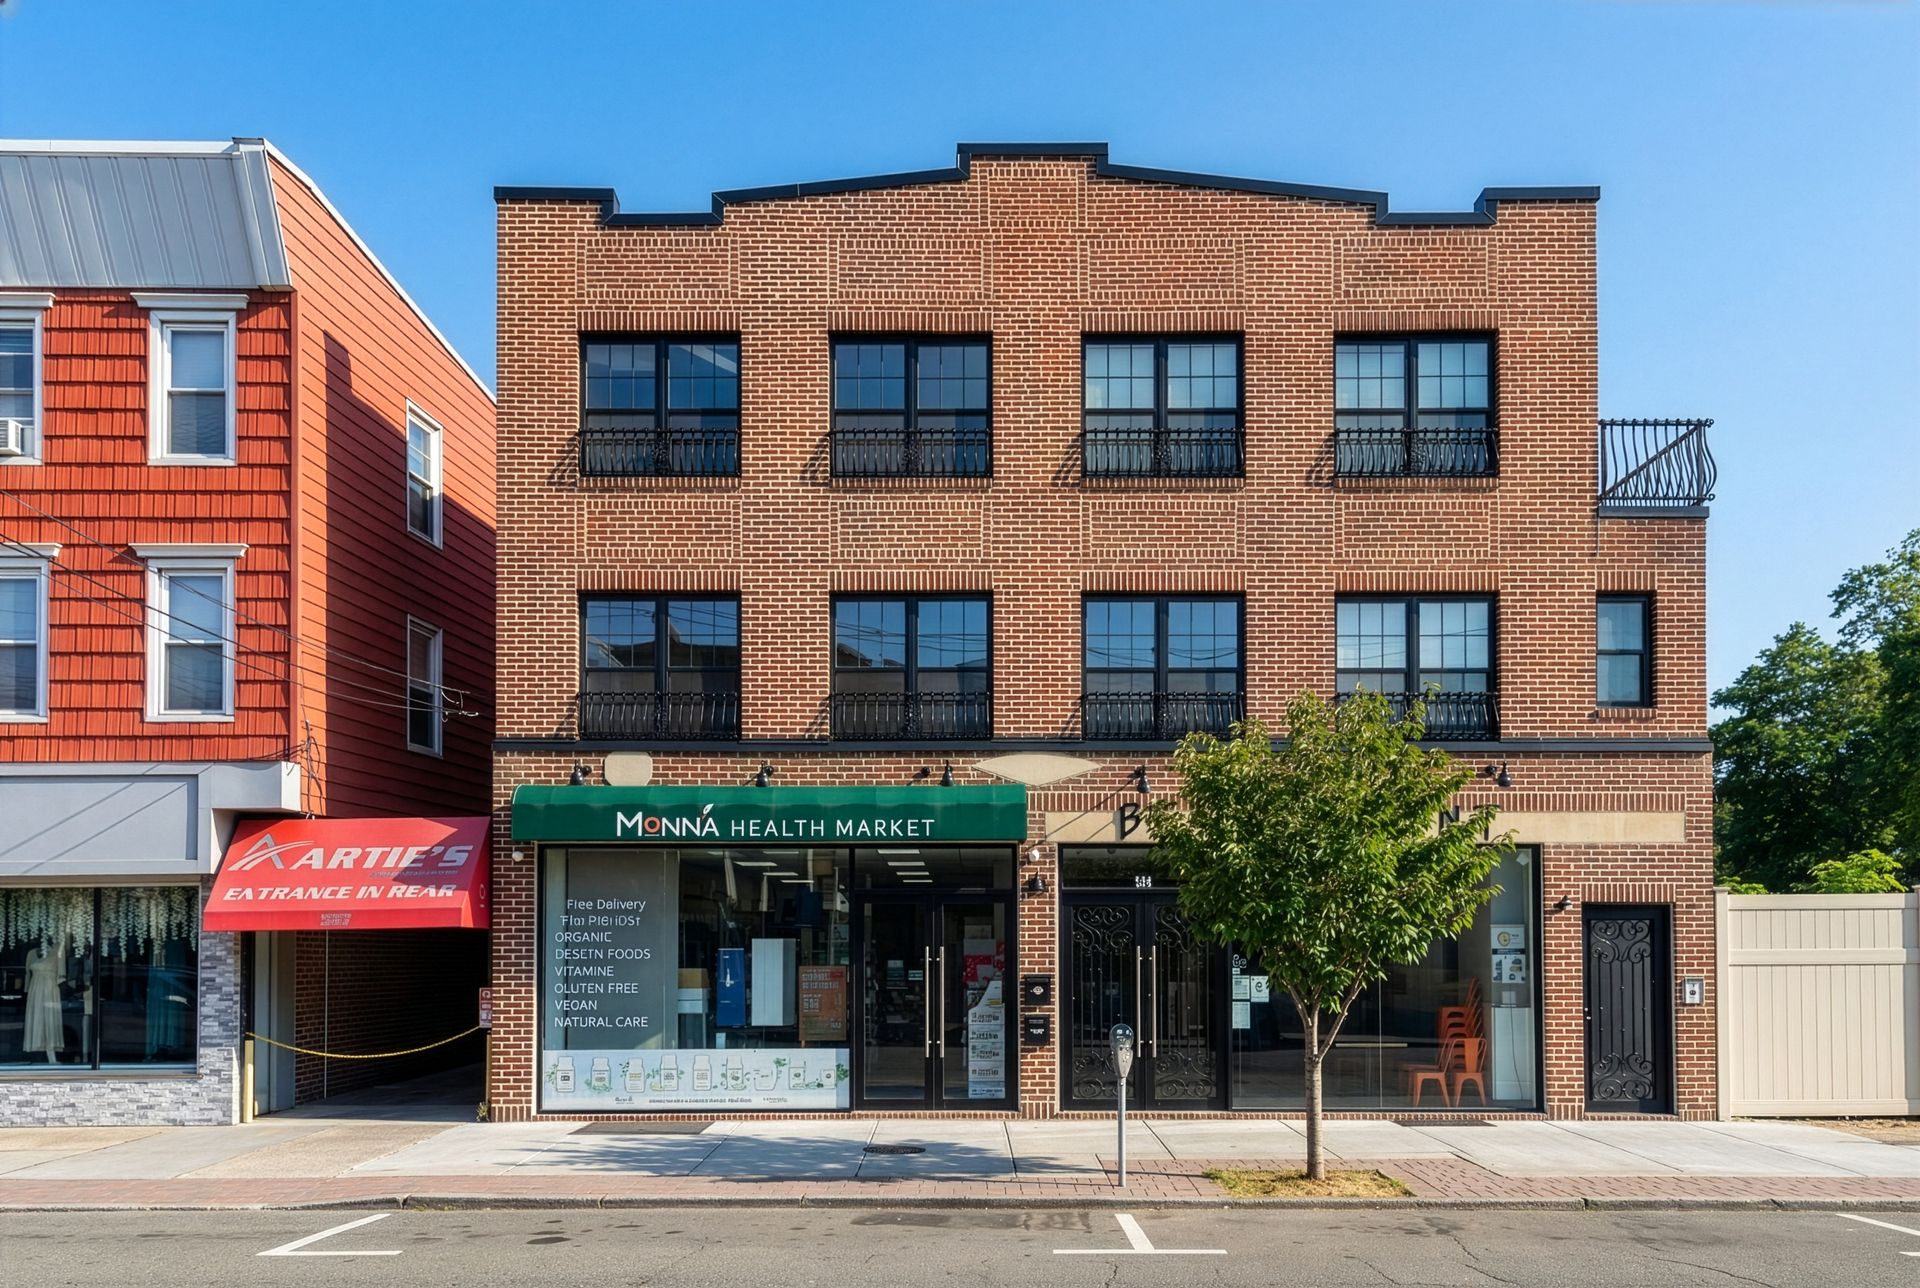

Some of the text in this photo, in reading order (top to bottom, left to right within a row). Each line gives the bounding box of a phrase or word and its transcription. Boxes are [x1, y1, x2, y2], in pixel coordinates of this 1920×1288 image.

[730, 819, 825, 837] HEALTH
[835, 819, 935, 837] MARKET
[288, 844, 474, 870] ARTIE'S
[355, 885, 385, 900] IN
[386, 884, 457, 899] REAR
[554, 931, 613, 943] ORGANIC
[607, 948, 651, 960] FOODS
[554, 965, 615, 977] VITAMINE
[607, 982, 640, 994] FREE
[554, 1016, 649, 1028] NATURAL CARE
